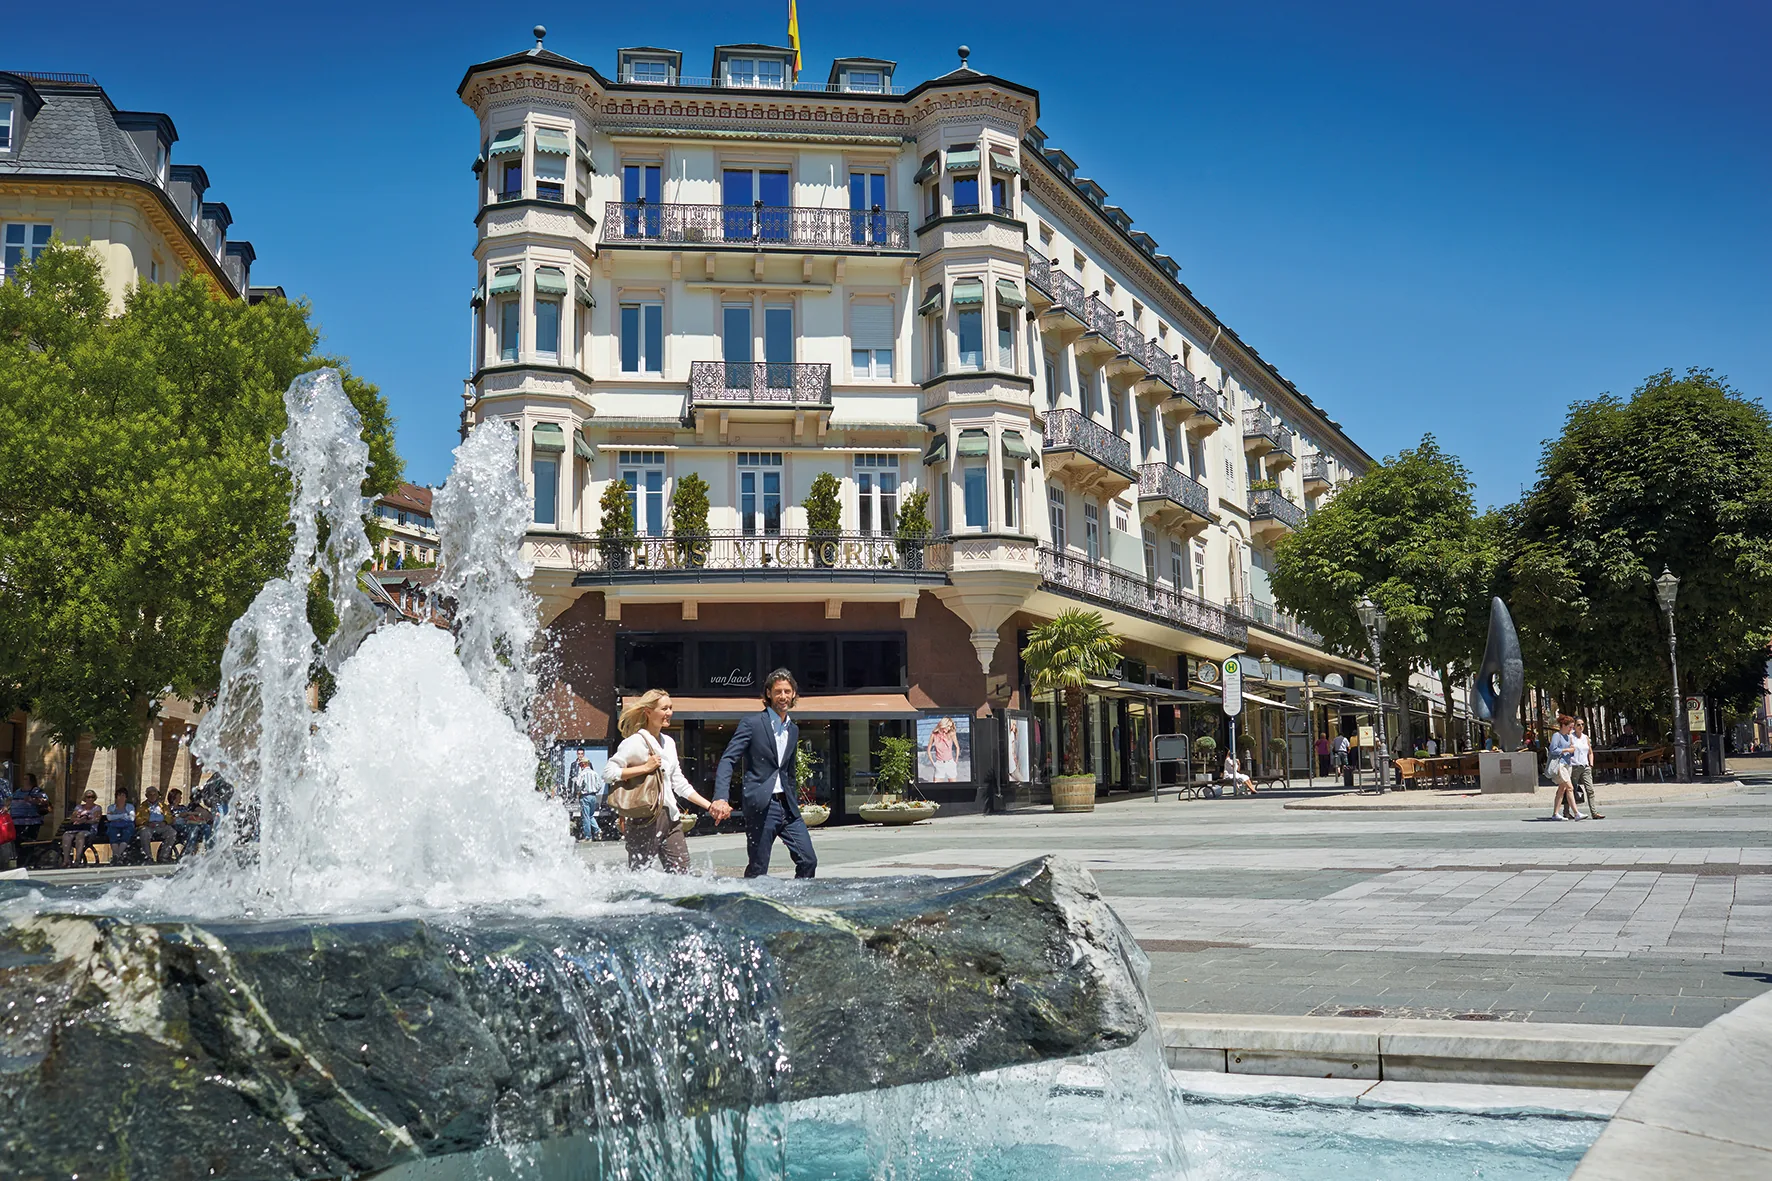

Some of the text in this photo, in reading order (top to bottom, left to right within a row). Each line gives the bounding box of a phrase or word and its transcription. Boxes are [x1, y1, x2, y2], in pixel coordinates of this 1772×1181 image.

[633, 540, 897, 567] HAUS VICTORIA
[710, 667, 755, 687] van Laack
